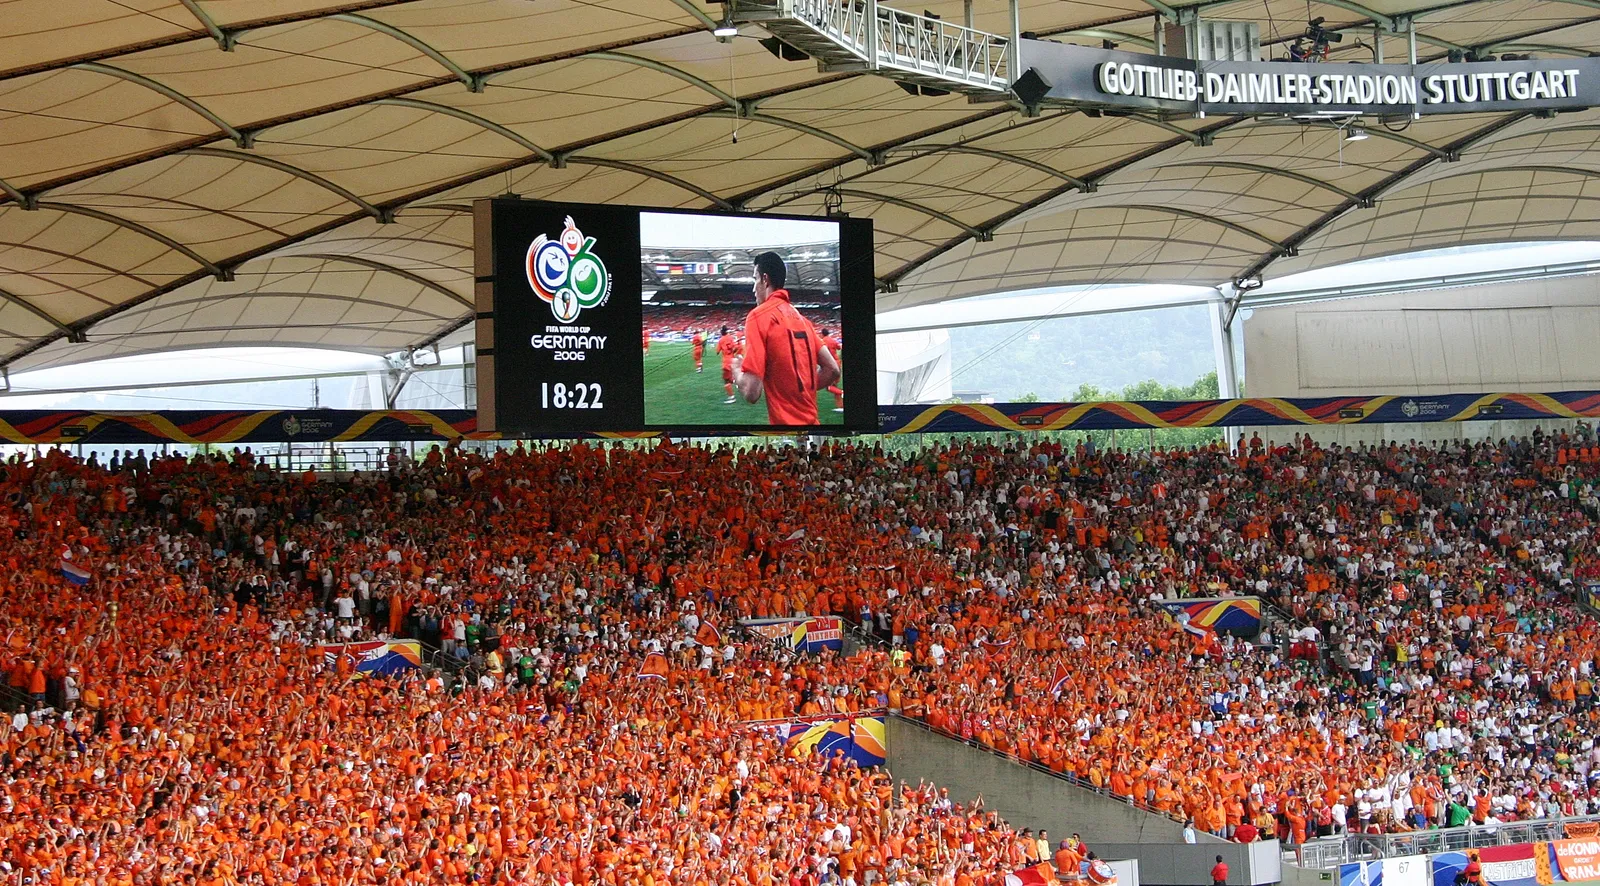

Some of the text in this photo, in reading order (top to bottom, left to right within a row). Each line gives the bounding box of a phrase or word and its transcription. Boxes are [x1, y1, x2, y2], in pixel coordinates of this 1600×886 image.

[1100, 61, 1580, 105] GOTTLIEB-DAIMLER-STADION STUTTGART
[545, 325, 559, 333] FIFA
[579, 326, 591, 334] CUP
[531, 335, 608, 350] GERMANY
[553, 350, 586, 361] 2006
[787, 328, 815, 392] 17
[541, 382, 604, 409] 18:22
[1398, 861, 1410, 874] 67
